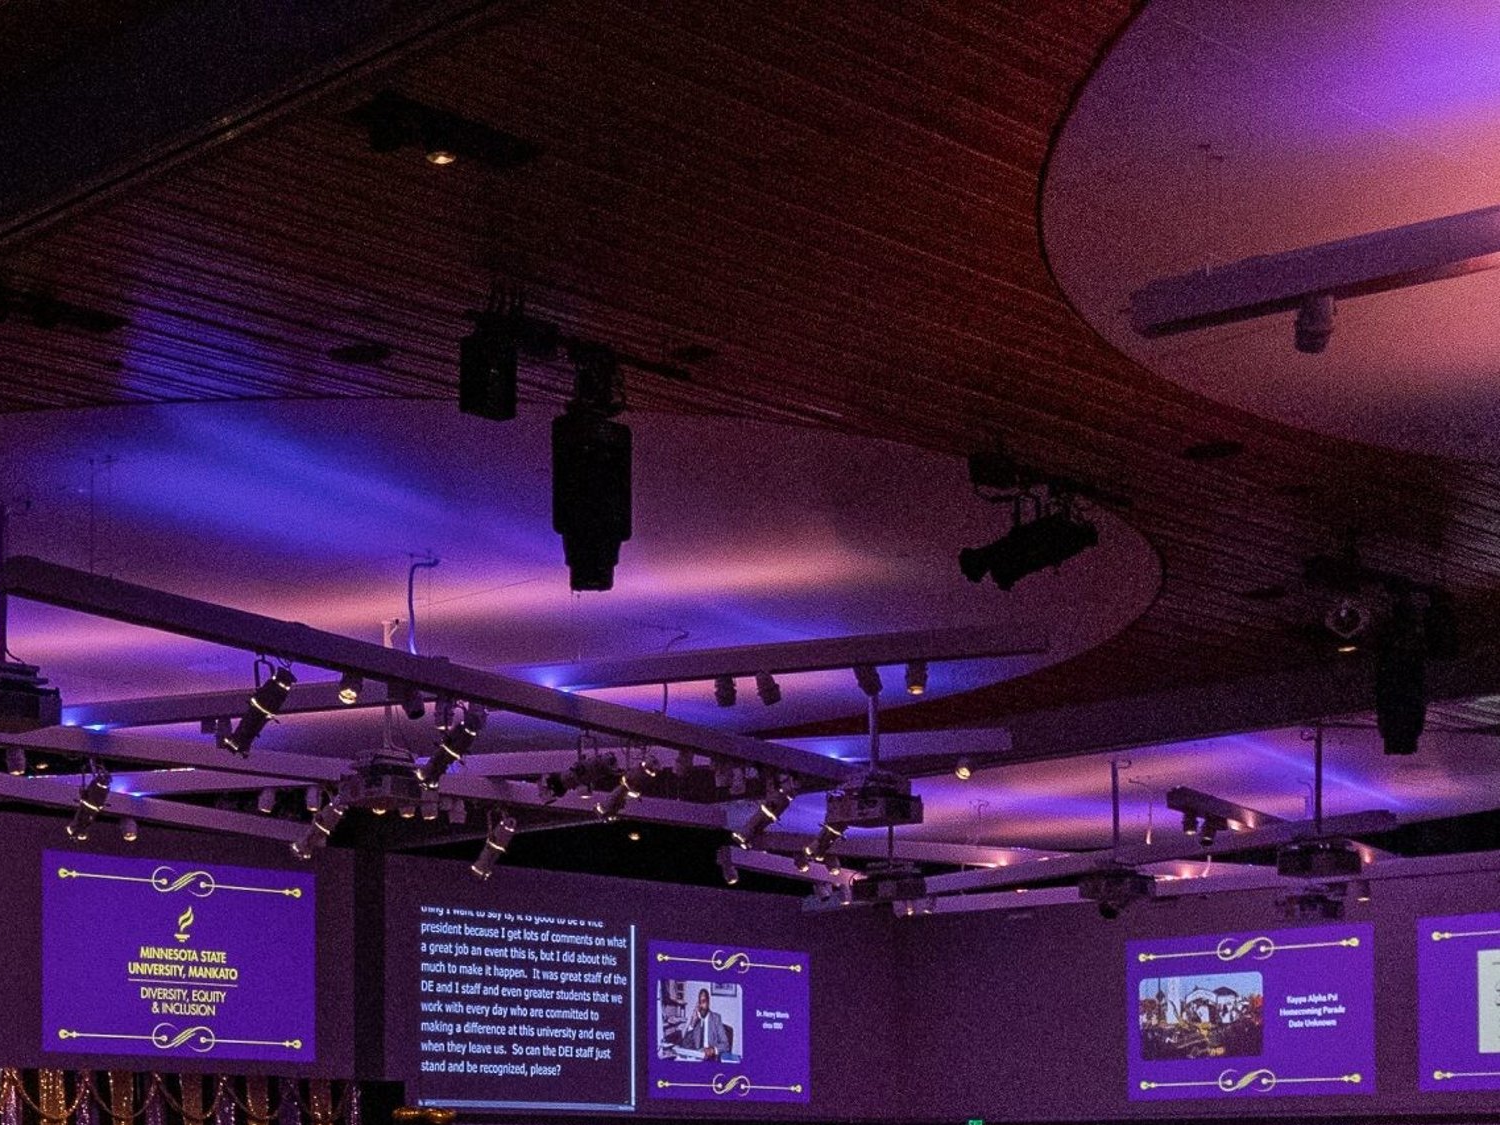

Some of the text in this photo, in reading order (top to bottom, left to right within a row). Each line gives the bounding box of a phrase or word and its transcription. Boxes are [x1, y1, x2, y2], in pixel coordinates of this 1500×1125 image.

[421, 922, 626, 948] president because I get lots of comments on what
[140, 946, 226, 964] MINNESOTA STATE
[421, 942, 616, 966] a great job an event this is, but I did about this
[128, 962, 238, 980] UNIVERSITY, MANKATO
[422, 962, 626, 985] much to make it happen. It was great staff of the
[141, 987, 226, 1002] DIVERSITY, EQUITY
[422, 980, 622, 1003] DE and I staff and even greater students that we
[152, 1002, 215, 1016] & INCLUSION
[422, 1000, 599, 1020] work with every day who are committed to
[421, 1020, 614, 1040] making a difference at this university and even
[421, 1040, 610, 1060] when they leave us. So can the DEI staff just
[422, 1060, 560, 1076] stand and be recognized, please?
